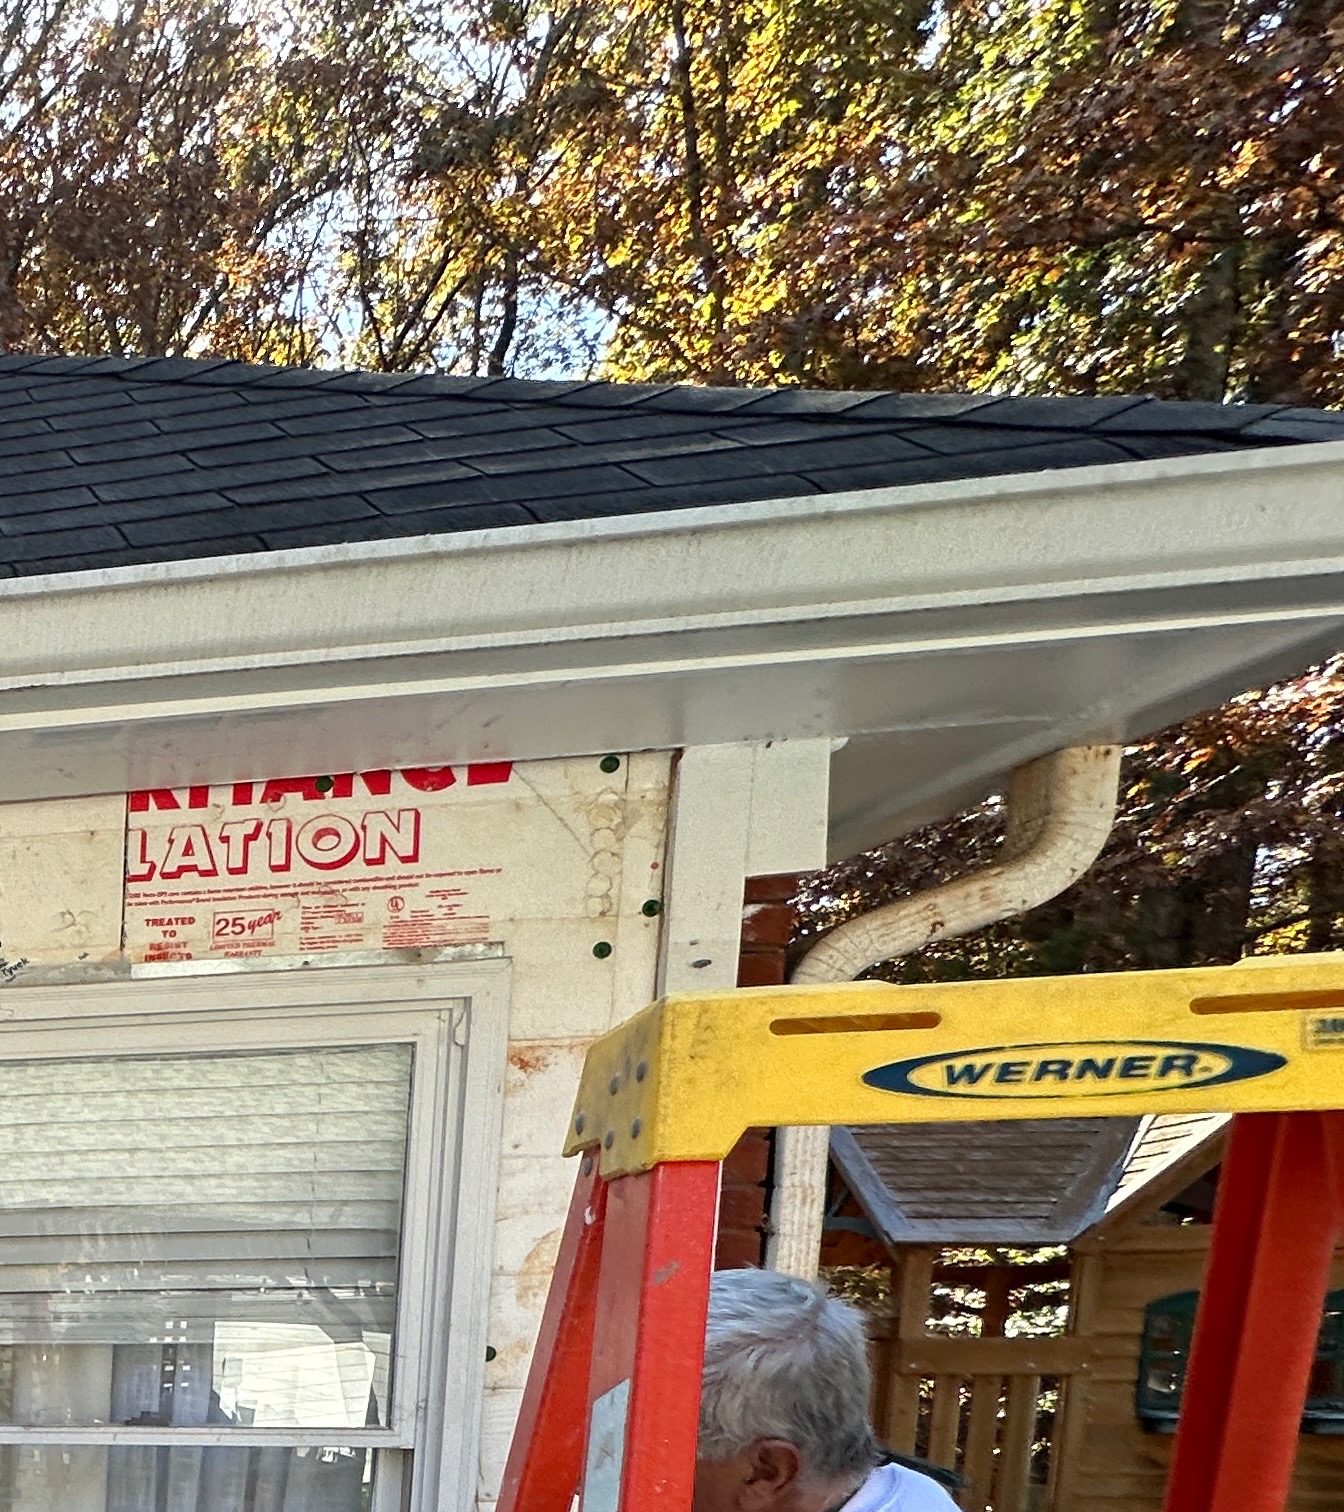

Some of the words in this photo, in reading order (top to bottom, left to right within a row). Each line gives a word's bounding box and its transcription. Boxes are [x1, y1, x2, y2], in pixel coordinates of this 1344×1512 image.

[144, 916, 196, 927] TREATED
[215, 916, 246, 937] 25
[247, 909, 283, 935] year
[161, 929, 177, 938] TO
[0, 956, 30, 978] Tyvek
[942, 1052, 1201, 1088] WERNER
